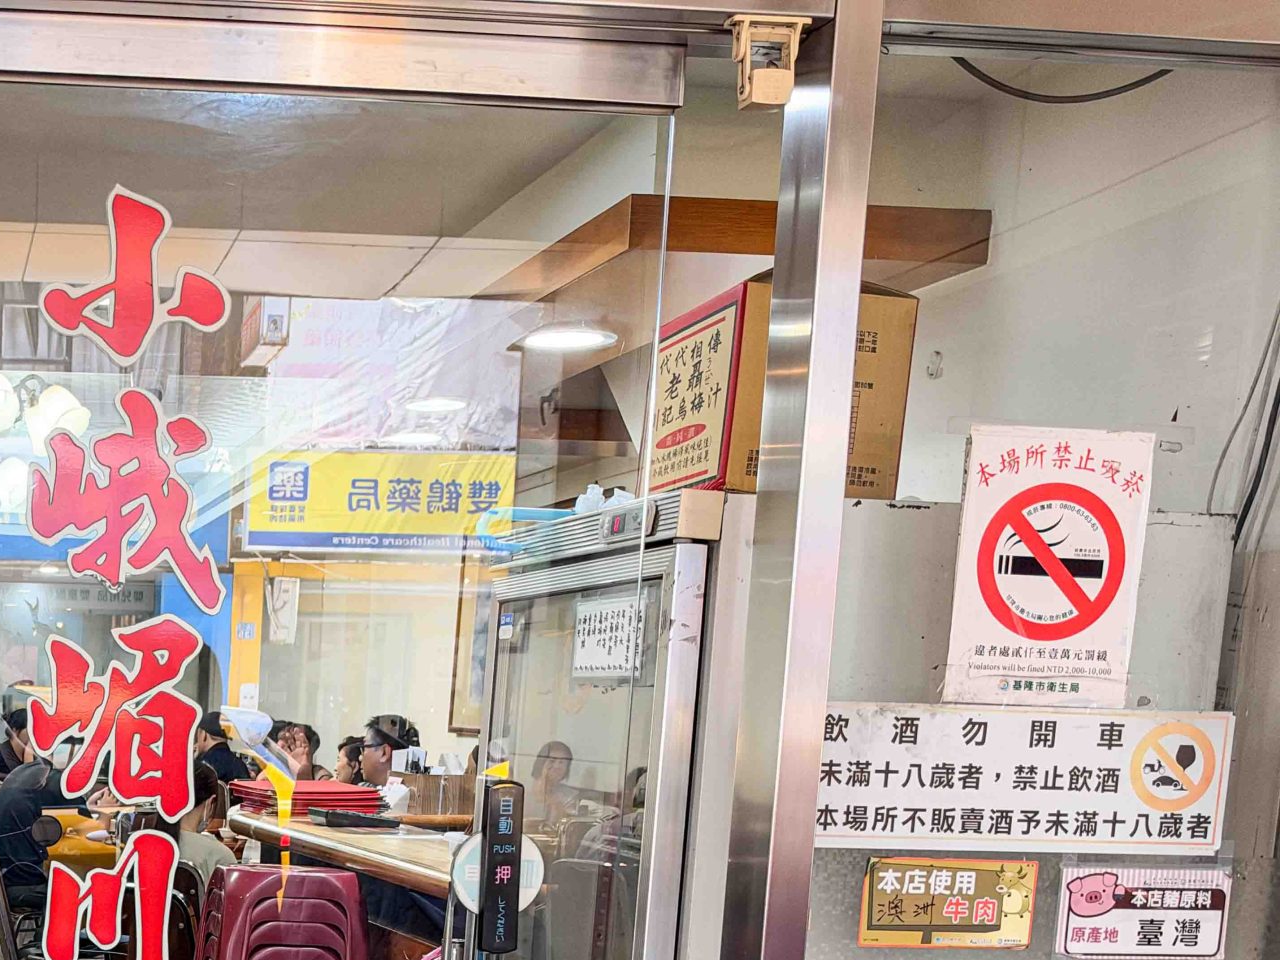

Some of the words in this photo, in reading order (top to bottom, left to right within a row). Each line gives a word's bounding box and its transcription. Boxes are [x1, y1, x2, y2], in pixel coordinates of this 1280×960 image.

[660, 328, 723, 375] 代代相傳
[661, 383, 723, 427] 記烏梅汁
[976, 441, 1144, 499] 本場所禁止吸菸
[968, 662, 1001, 671] Violators
[1002, 663, 1016, 671] will
[1017, 663, 1026, 672] be
[1027, 664, 1045, 673] fined
[1046, 665, 1064, 674] NTD
[1065, 666, 1112, 676] 2,000-10,000
[1012, 680, 1080, 693] 基隆市衛生局
[824, 714, 1126, 751] 飲酒勿開車
[820, 759, 1121, 794] 未滿十八歲者，禁止飲酒
[498, 797, 514, 835] 自動
[816, 804, 1212, 839] 本場所不販賣酒予未滿十八歲者
[493, 845, 516, 854] PUSH
[495, 866, 512, 885] 押
[877, 869, 977, 895] 本店使用
[942, 896, 998, 925] 牛肉
[1130, 890, 1212, 909] 本店豬原料
[1070, 926, 1119, 944] 原產地
[1135, 919, 1201, 947] 臺灣
